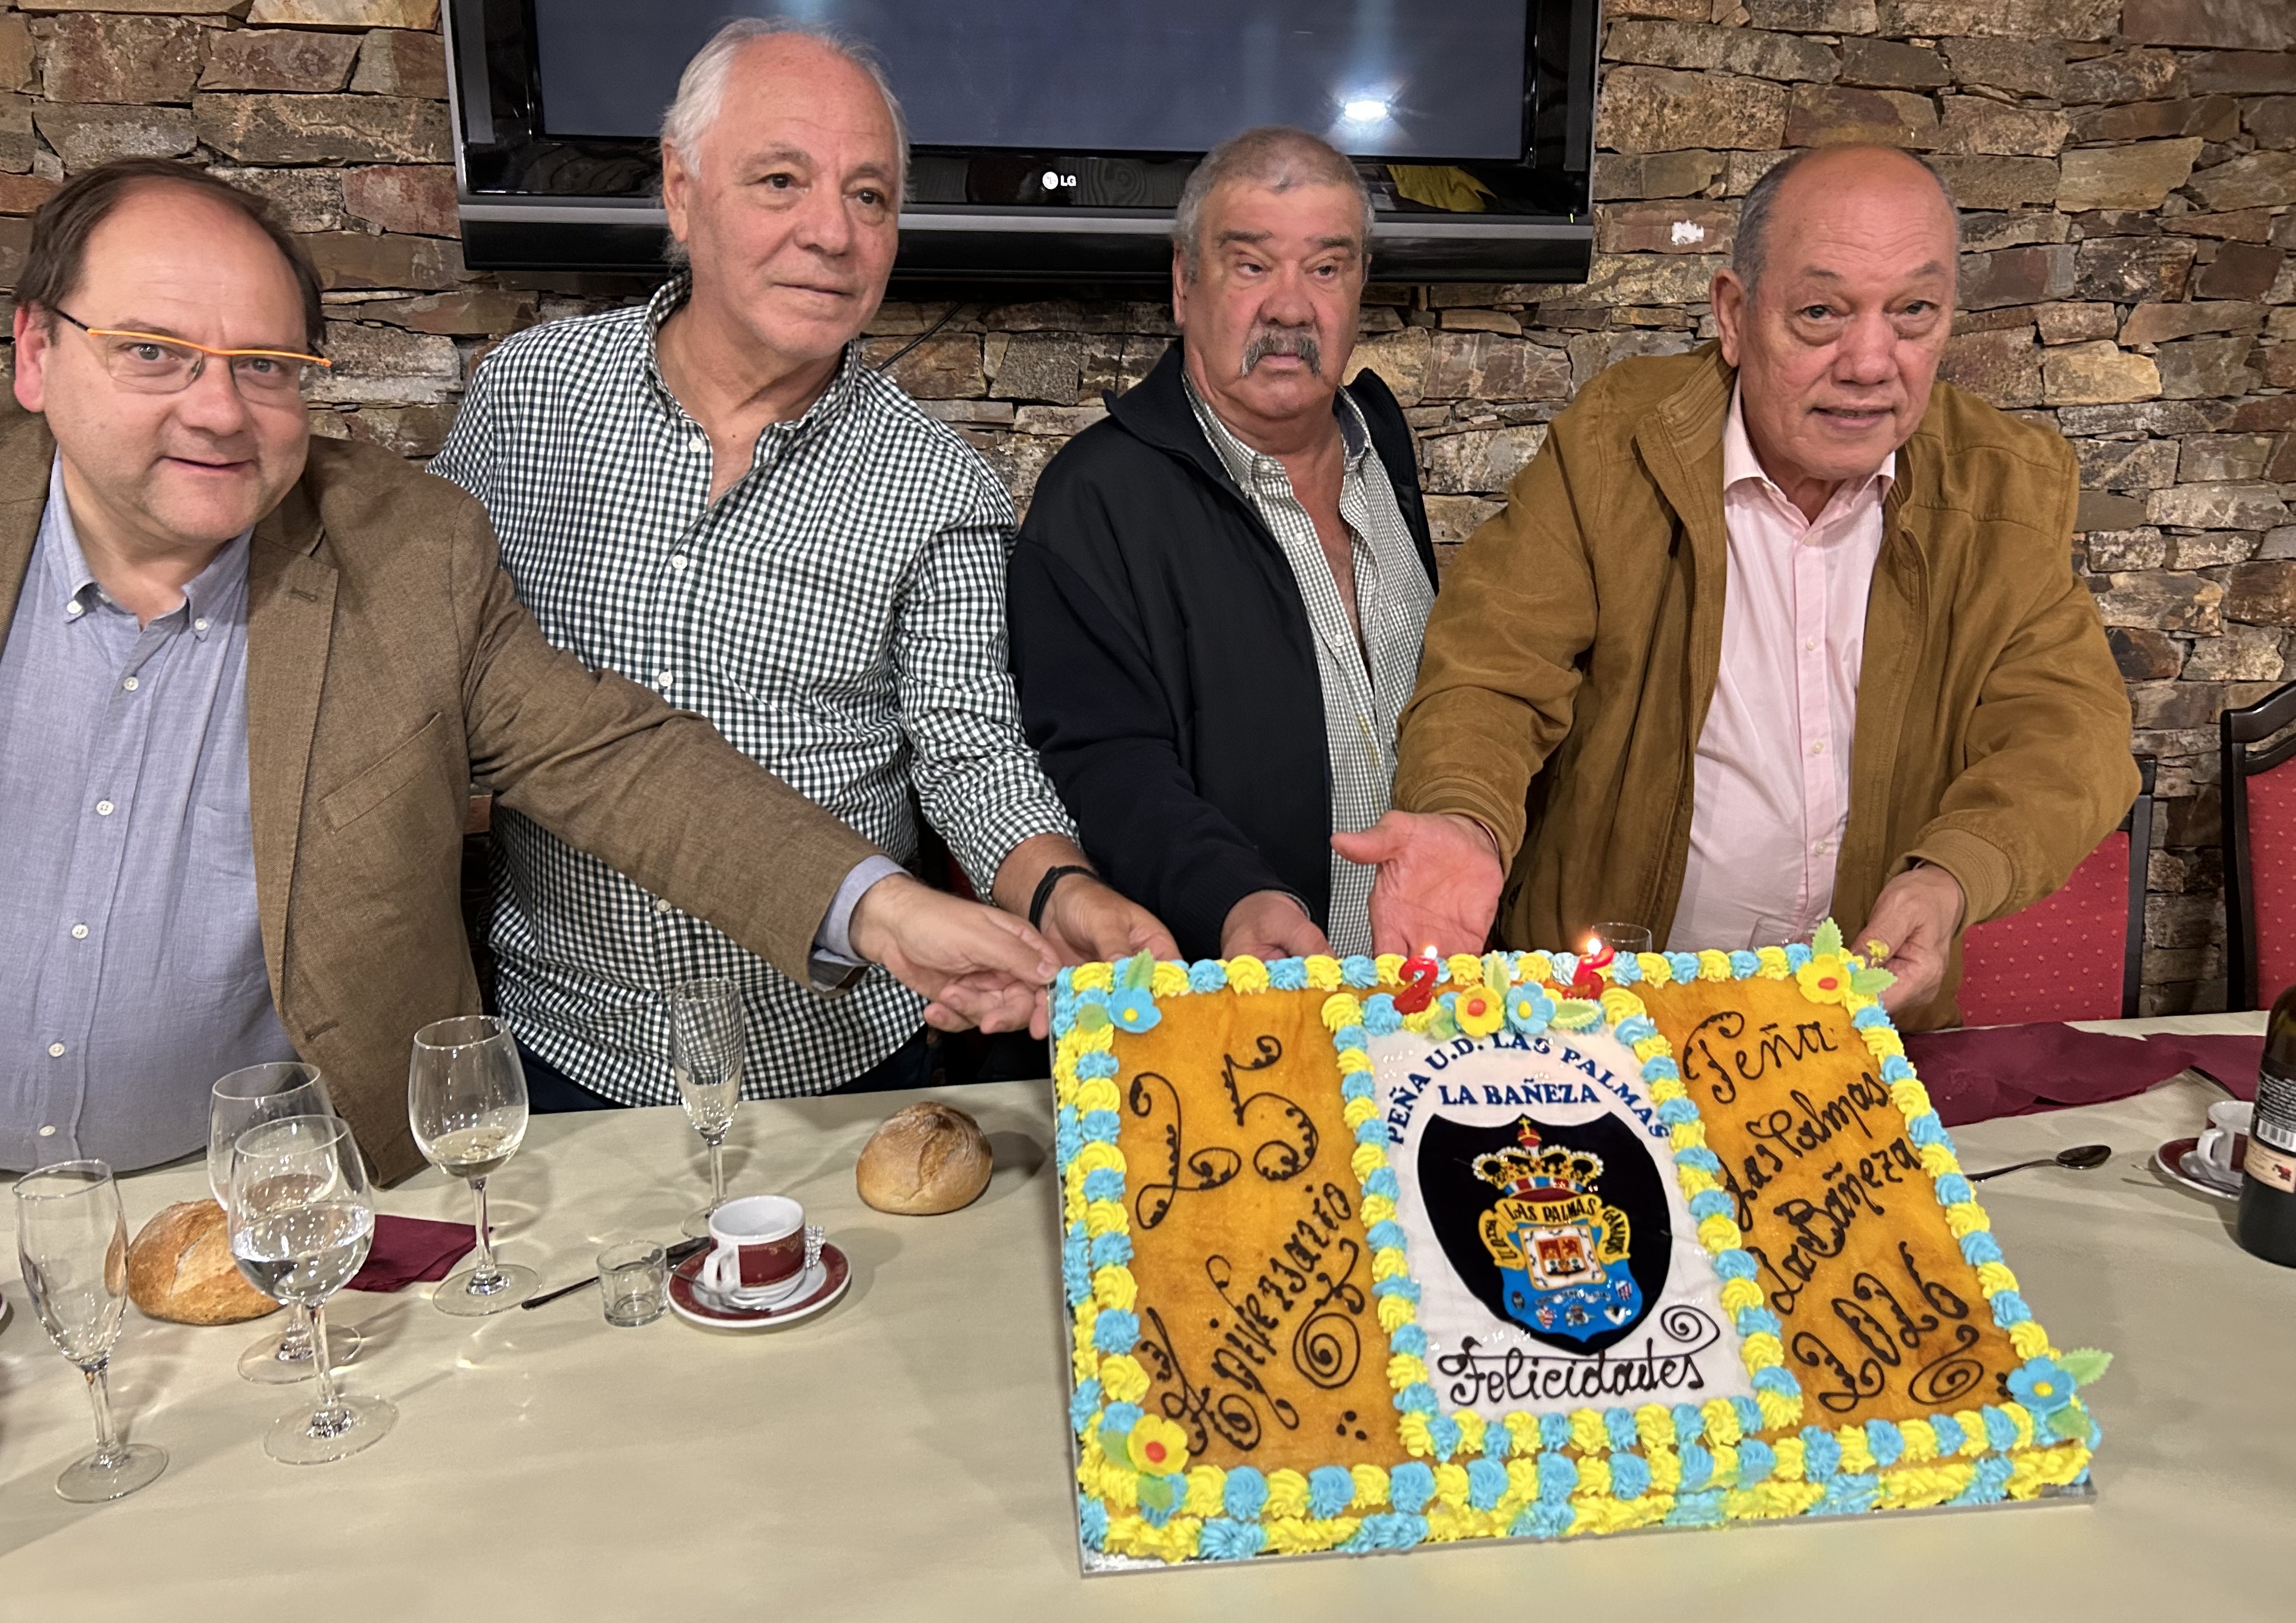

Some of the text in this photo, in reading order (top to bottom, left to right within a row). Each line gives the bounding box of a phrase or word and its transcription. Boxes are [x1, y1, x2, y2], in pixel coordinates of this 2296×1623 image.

[1060, 175, 1076, 186] LG
[1387, 1073, 1431, 1145] PEÑA
[1490, 1032, 1550, 1055] LAS
[1560, 1046, 1669, 1138] PALMAS
[1437, 1078, 1601, 1105] LA BAÑEZA
[1682, 1010, 1839, 1104] Peña
[1129, 1034, 1319, 1231] 25
[1746, 1070, 1889, 1159] Palmas
[1502, 1197, 1598, 1223] LAS PALMAS
[1773, 1136, 1922, 1258] Bañeza
[1139, 1181, 1352, 1457] Aniversario
[1792, 1241, 1970, 1413] 2026
[1437, 1336, 1705, 1406] Felicidades
